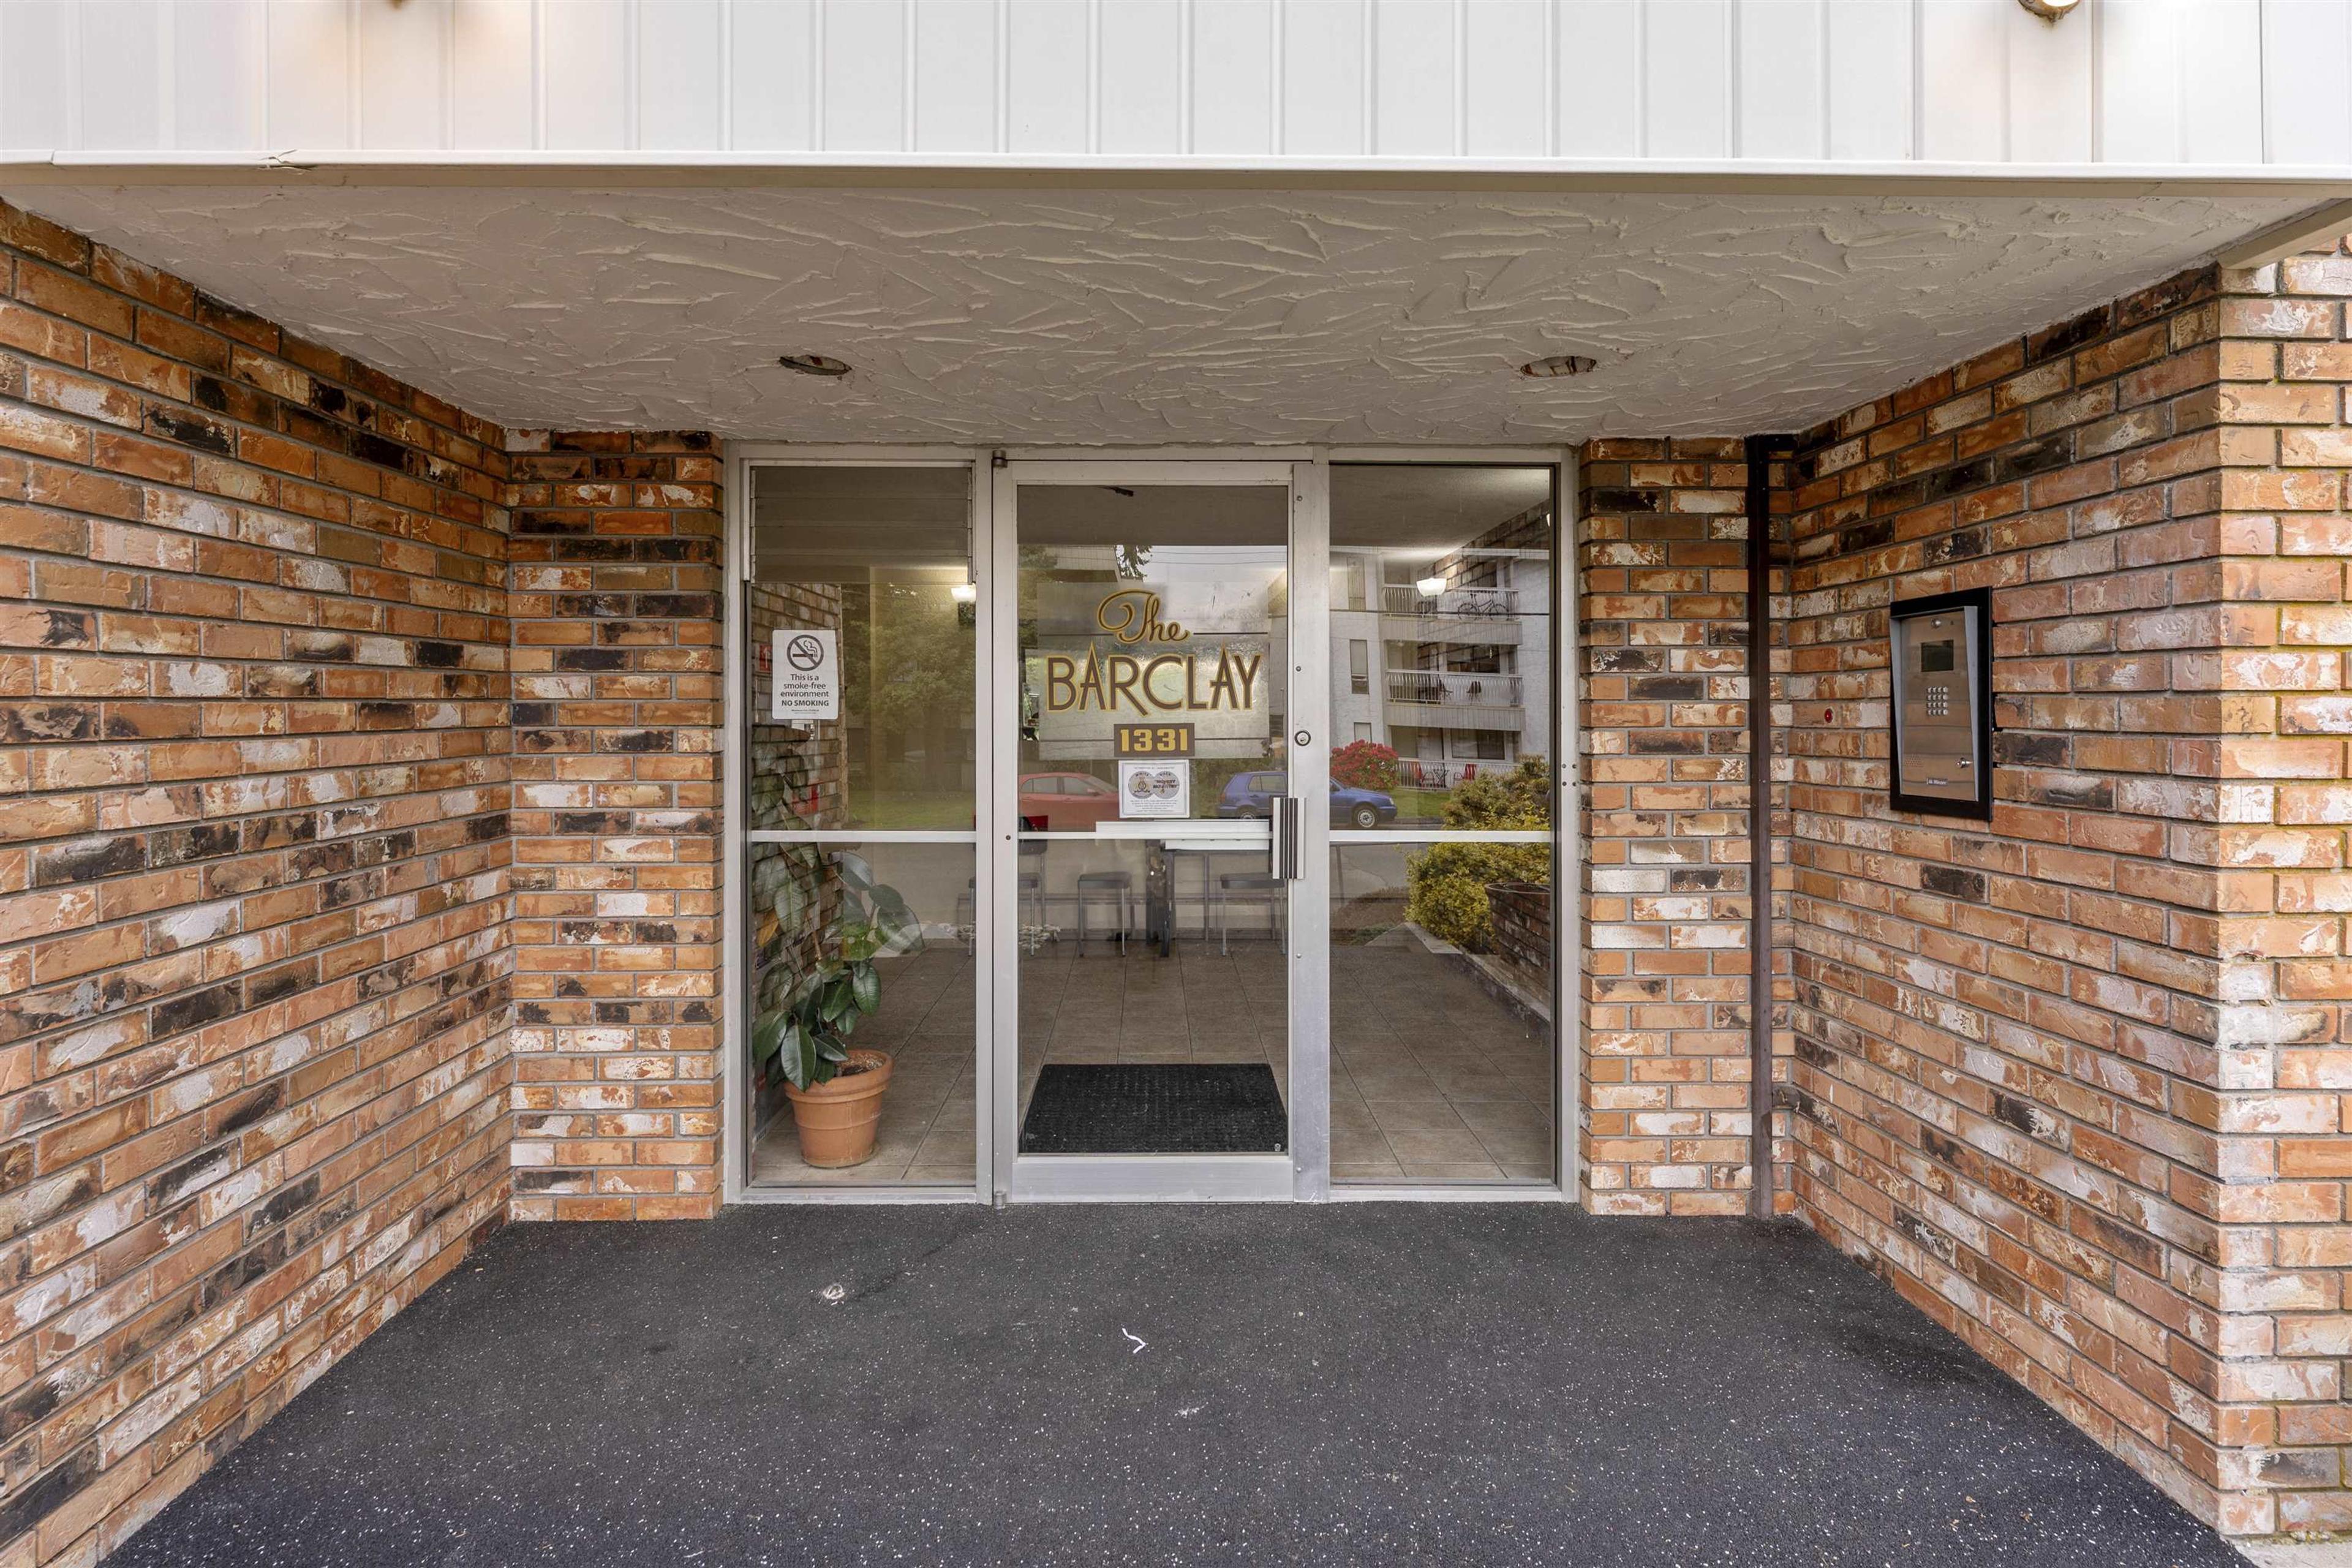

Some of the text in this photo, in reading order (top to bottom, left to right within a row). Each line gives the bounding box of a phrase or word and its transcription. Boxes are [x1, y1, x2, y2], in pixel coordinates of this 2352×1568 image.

[1097, 588, 1190, 644] The
[1047, 639, 1262, 717] BARCLAY
[1120, 728, 1188, 752] 1331
